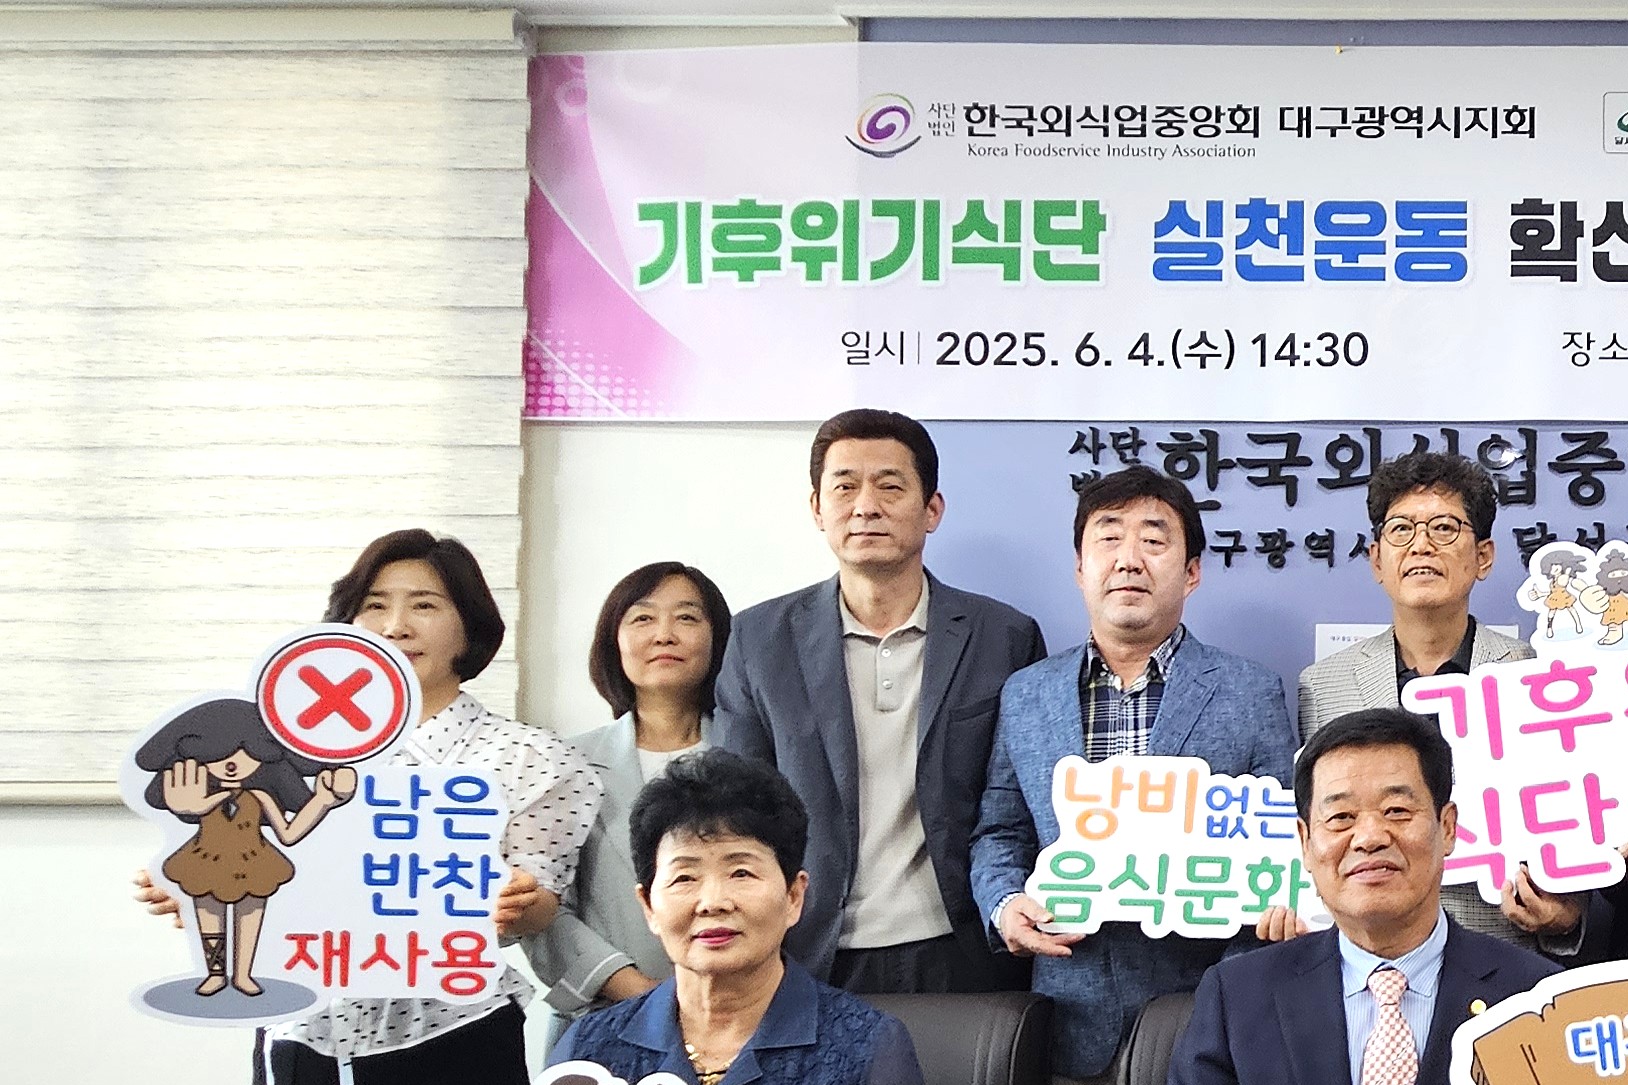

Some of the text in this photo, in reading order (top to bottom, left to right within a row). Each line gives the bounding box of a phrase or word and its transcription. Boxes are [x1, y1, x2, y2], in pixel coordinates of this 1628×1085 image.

[927, 120, 955, 137] 법인
[928, 102, 956, 120] 사단
[962, 102, 1536, 139] 한국외식업중앙회 대구광역시지회
[967, 143, 1256, 161] Korea Foodservice Industry Association
[635, 198, 1106, 285] 기후위기식단
[1152, 198, 1468, 282] 실천운동
[841, 328, 1369, 370] 일시 2025. 6. 4.(수) 14:30
[1066, 425, 1147, 466] 사단
[364, 774, 499, 841] 남은
[1065, 766, 1297, 840] 낭비 없는
[1443, 773, 1620, 890] 식단
[362, 853, 500, 917] 반찬
[1038, 851, 1311, 925] 음식문화
[285, 930, 495, 996] 재사용
